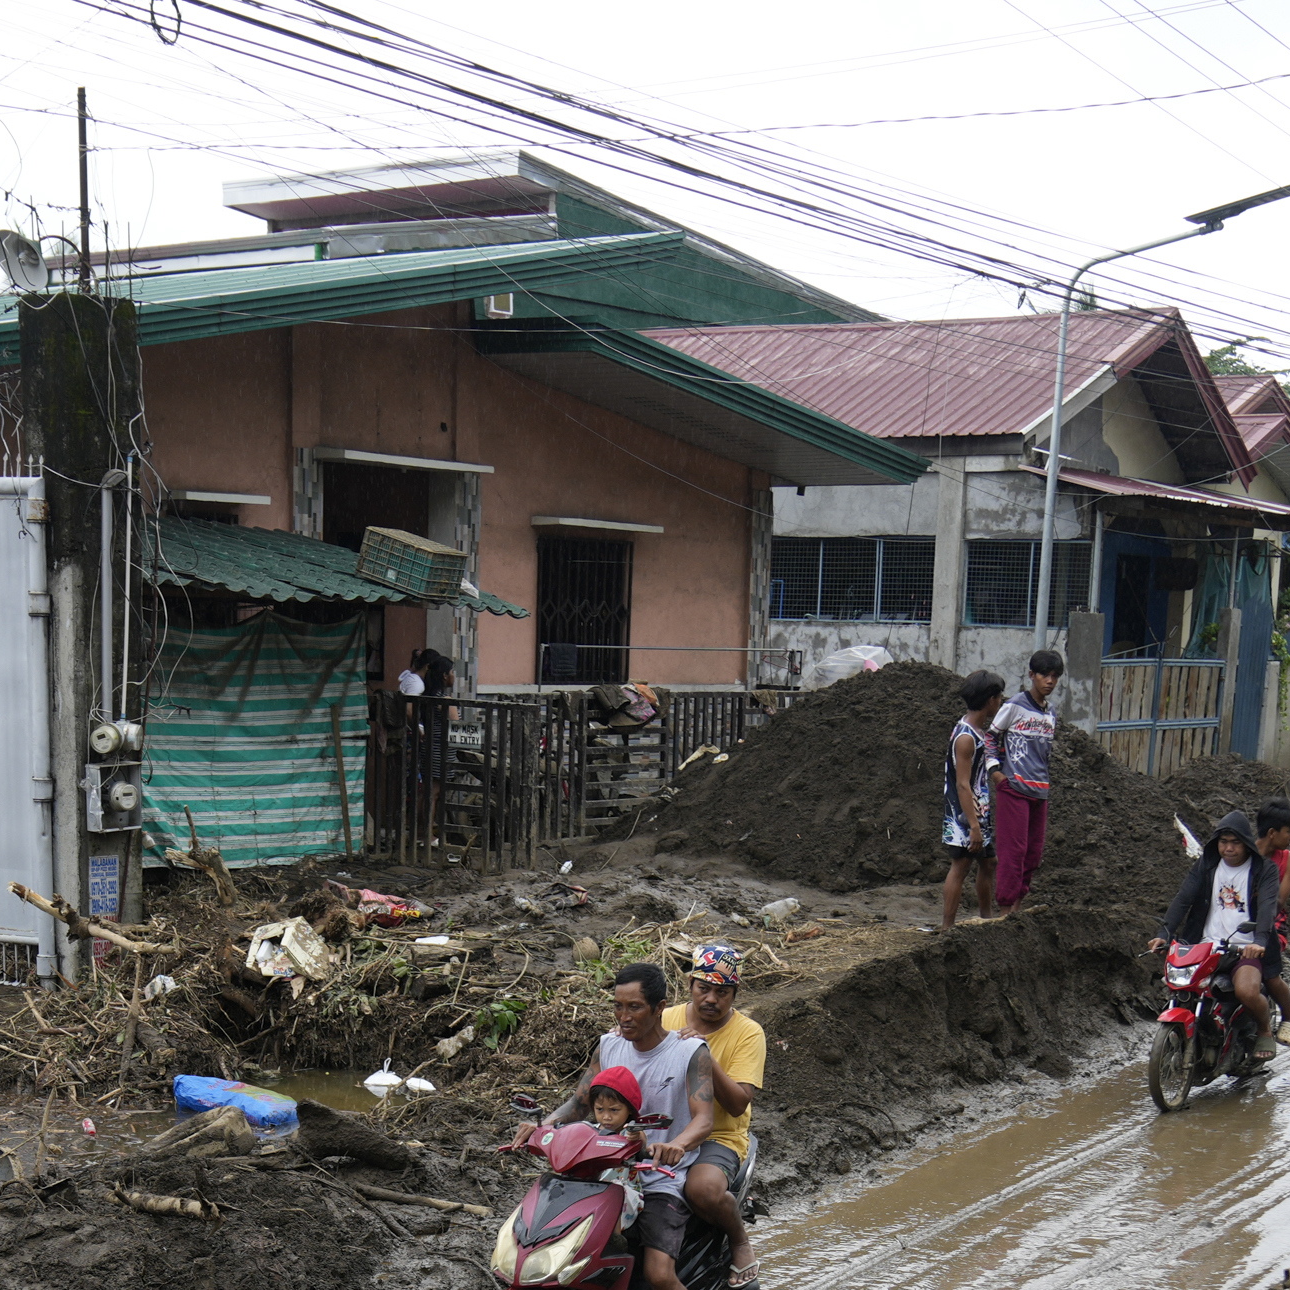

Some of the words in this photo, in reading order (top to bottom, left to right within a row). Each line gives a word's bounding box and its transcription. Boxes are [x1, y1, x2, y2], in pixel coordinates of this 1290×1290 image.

[450, 724, 459, 733] NO
[462, 724, 479, 735] MASK
[449, 735, 457, 743] NO
[460, 735, 480, 745] ENTRY
